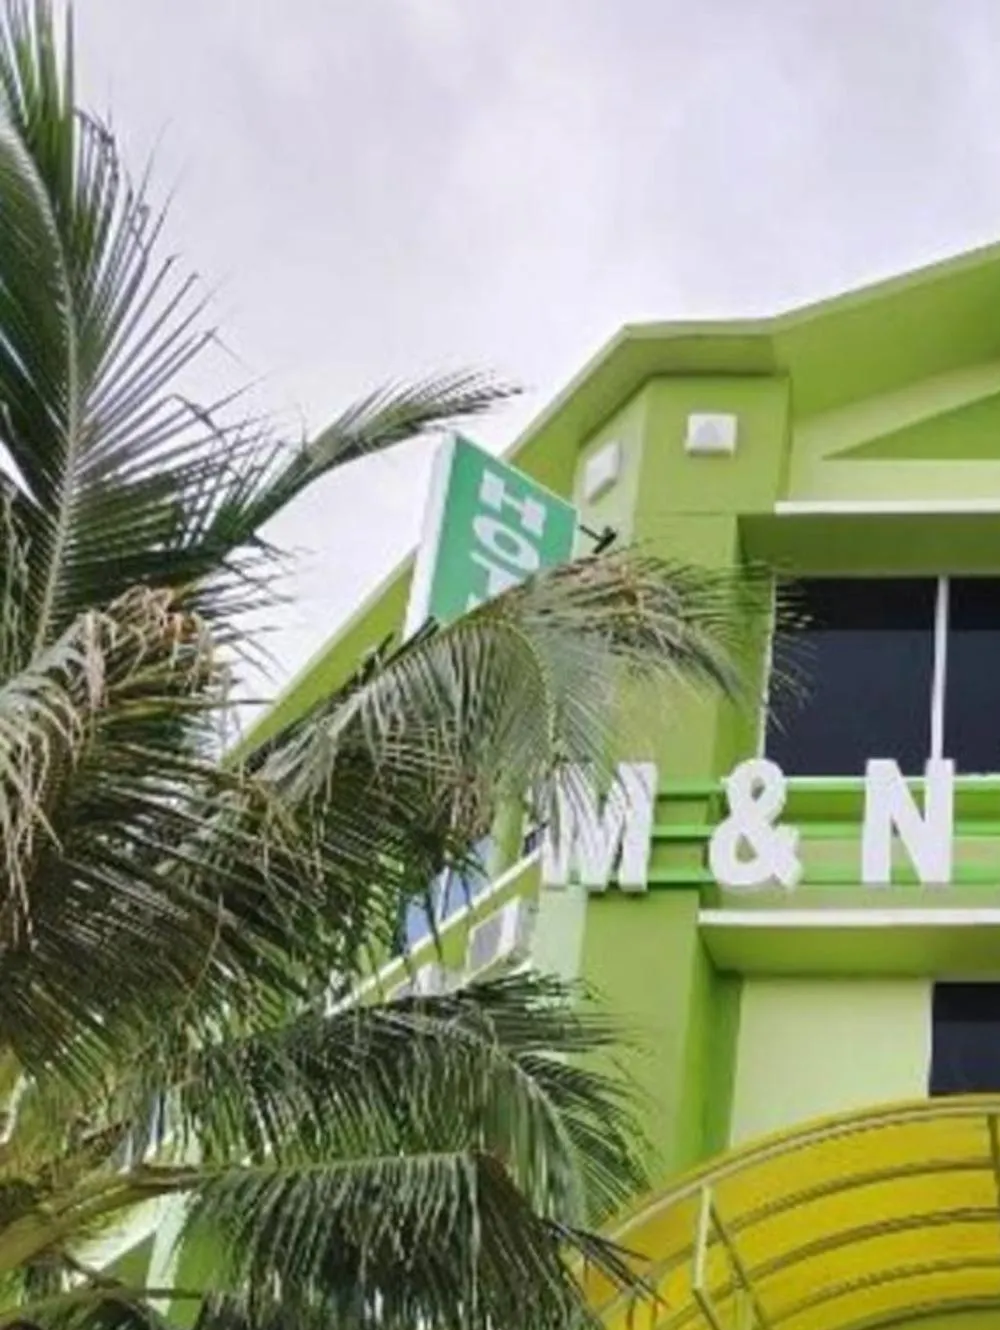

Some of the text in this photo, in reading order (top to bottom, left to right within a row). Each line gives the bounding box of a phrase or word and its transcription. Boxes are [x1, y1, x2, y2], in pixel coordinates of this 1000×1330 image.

[465, 468, 548, 614] HOT
[537, 760, 659, 892] M
[708, 757, 802, 892] &
[860, 756, 956, 886] N
